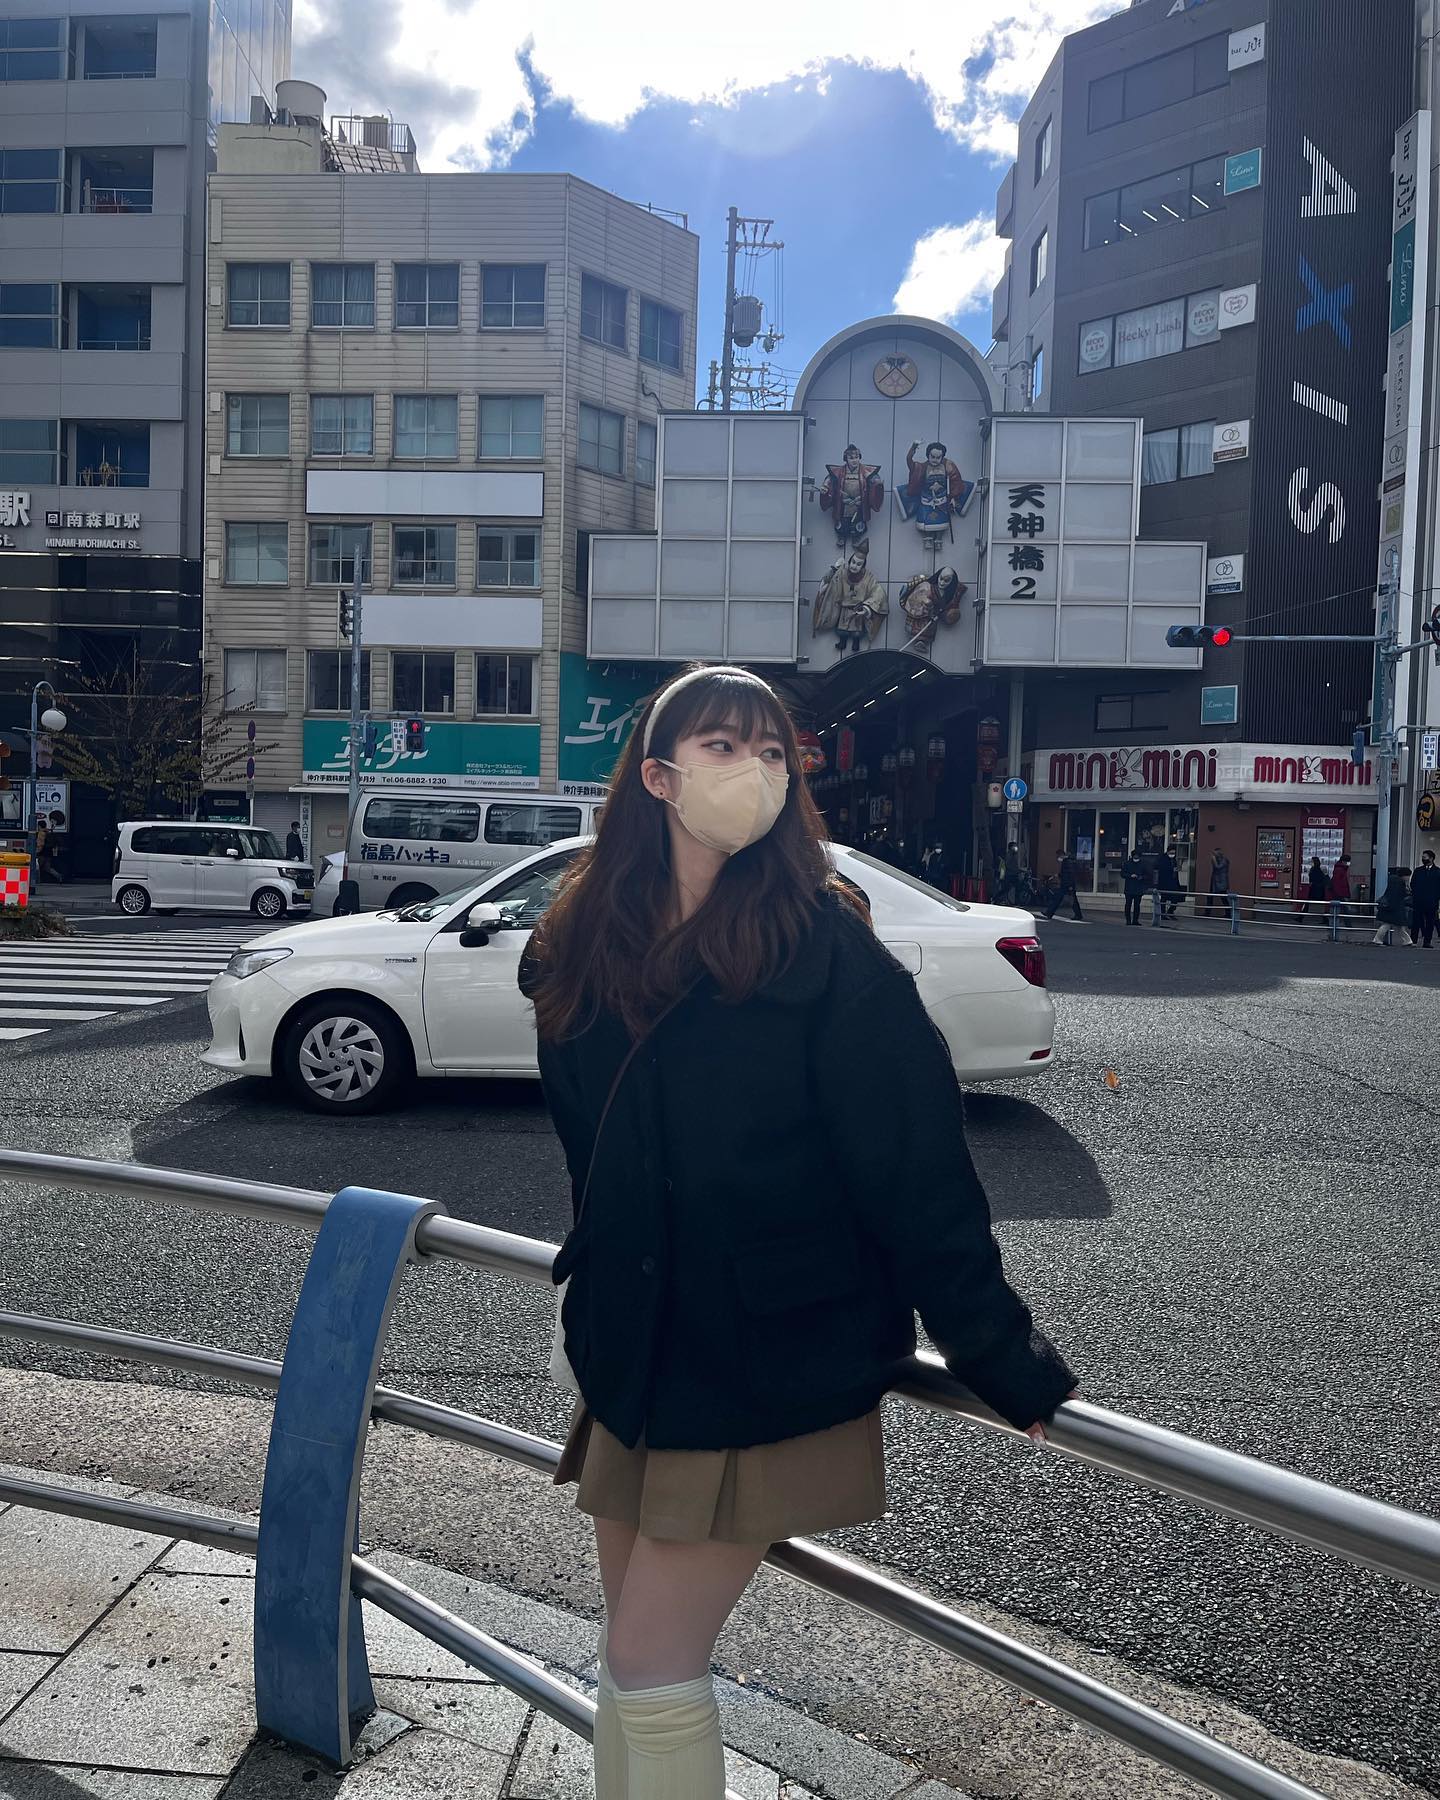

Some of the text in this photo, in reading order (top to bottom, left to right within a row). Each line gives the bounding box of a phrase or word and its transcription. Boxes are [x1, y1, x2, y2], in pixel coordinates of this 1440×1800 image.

[1193, 306, 1215, 319] BECKY
[1193, 314, 1215, 326] LASH
[1118, 318, 1182, 344] Becky Lash
[0, 491, 31, 526] 駅
[66, 511, 140, 528] 南森町駅
[45, 538, 125, 549] MINAMI-MORIMACHI
[1007, 485, 1045, 600] 天神橋2
[1049, 749, 1217, 790] mini mini
[1254, 756, 1304, 783] mini
[1321, 758, 1372, 785] mini
[382, 776, 447, 785] Tel.06-6882-1230
[36, 792, 61, 803] FLO
[361, 842, 450, 864] 福島ハッキョ
